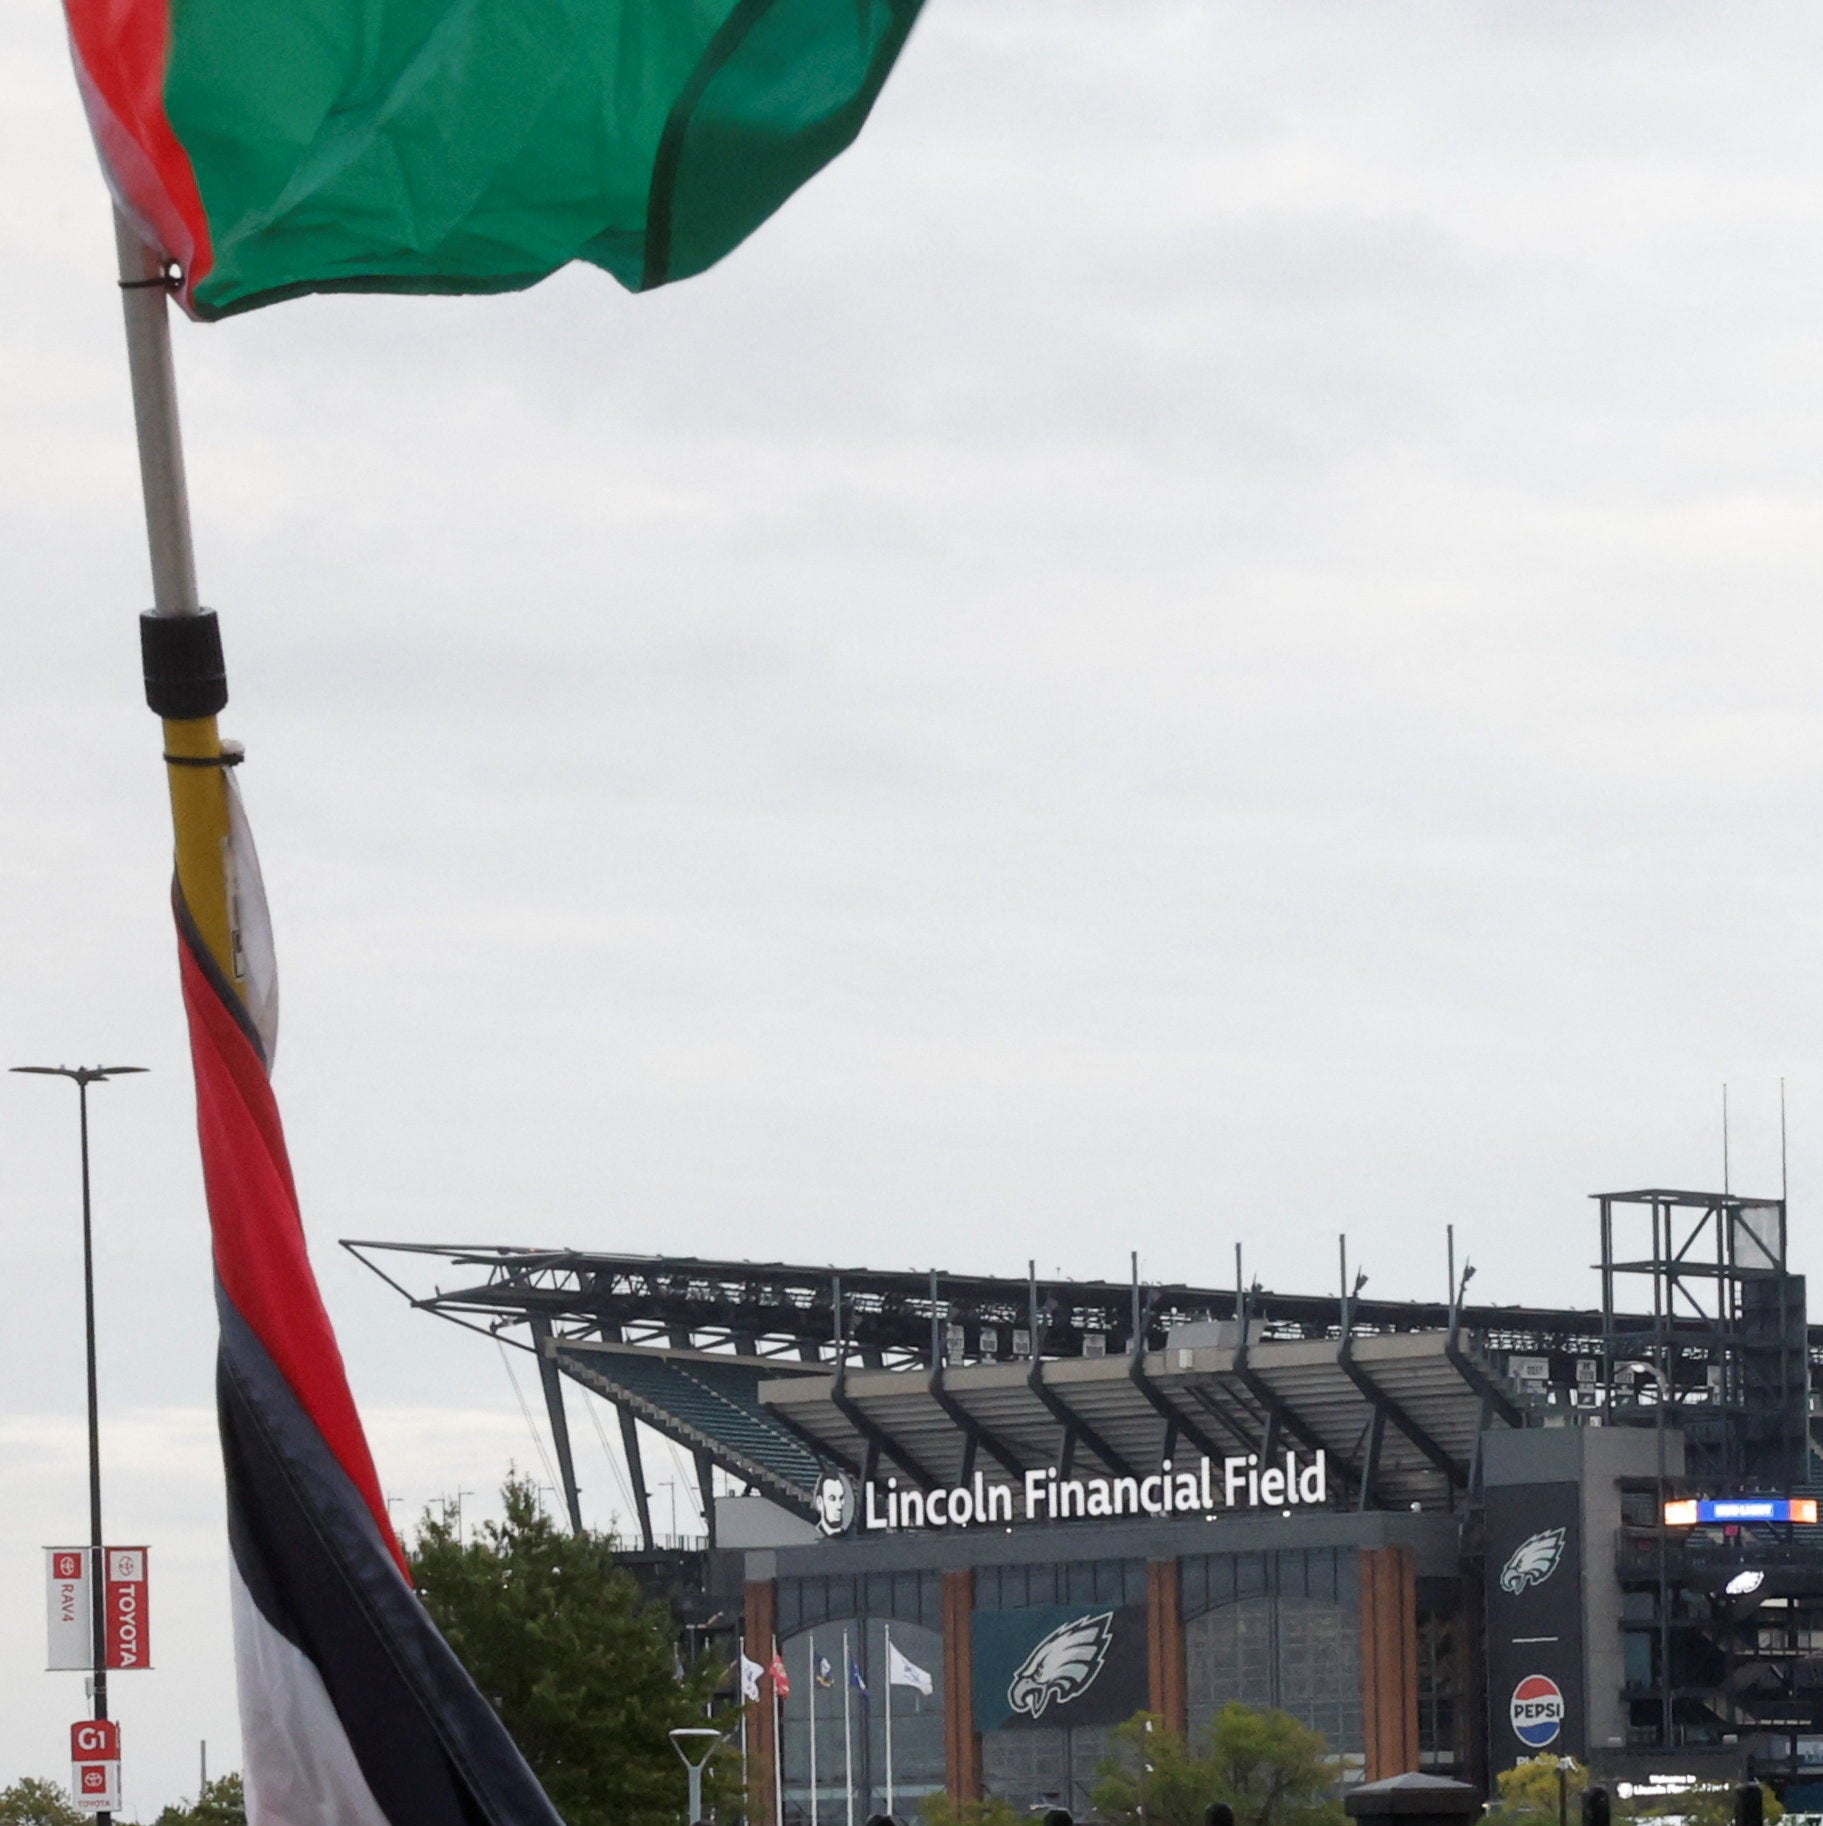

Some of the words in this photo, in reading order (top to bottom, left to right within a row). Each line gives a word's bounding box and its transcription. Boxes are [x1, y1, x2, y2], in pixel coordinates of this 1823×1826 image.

[865, 1470, 1013, 1530] Lincoln
[1024, 1456, 1214, 1520] Financial
[1223, 1448, 1328, 1507] Field
[60, 1583, 75, 1623] RAV4
[118, 1583, 138, 1668] TOYOTA
[1513, 1702, 1561, 1719] PEPSI
[77, 1727, 106, 1751] G1
[77, 1800, 111, 1808] TOYOTA
